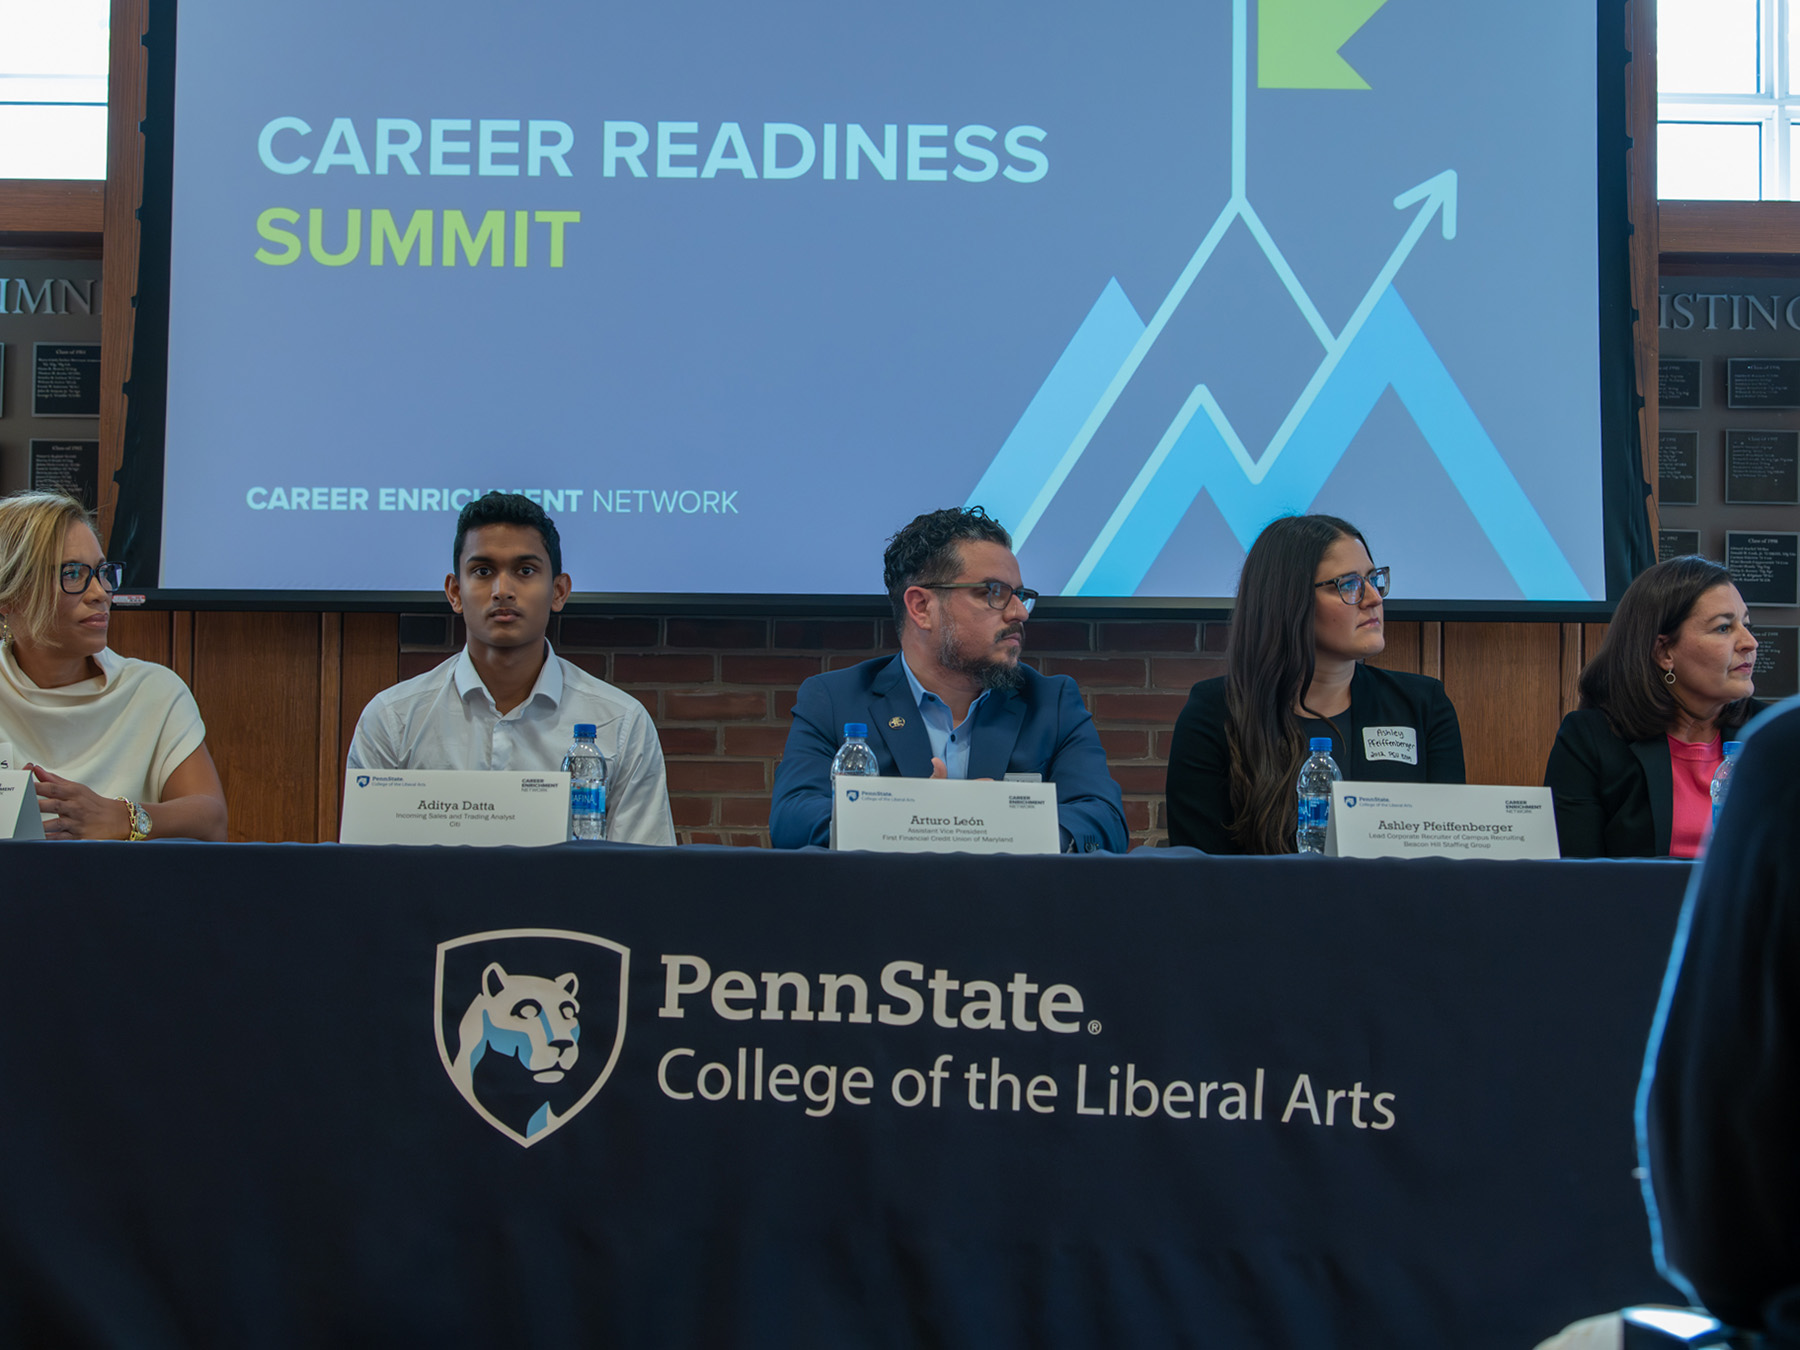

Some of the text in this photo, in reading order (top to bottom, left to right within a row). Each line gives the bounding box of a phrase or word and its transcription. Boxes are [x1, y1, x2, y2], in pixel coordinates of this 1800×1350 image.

[258, 116, 1049, 183] CAREER READINESS
[254, 207, 581, 268] SUMMIT
[246, 487, 738, 514] CAREER ENRICENT NETWORK
[1377, 729, 1404, 739] Ashley
[1367, 739, 1416, 751] Pfeiffenberger
[417, 800, 495, 812] Aditya Datta
[395, 812, 427, 820] Incoming
[428, 812, 447, 820] Sales
[464, 813, 489, 821] Trading
[491, 813, 515, 821] Analyst
[911, 815, 984, 826] Arturo León
[1378, 820, 1513, 834] Ashley Pfeiffenberger
[1387, 833, 1420, 841] Corporate
[1461, 834, 1489, 842] Campus
[658, 1047, 1396, 1130] College of the Liberal Arts
